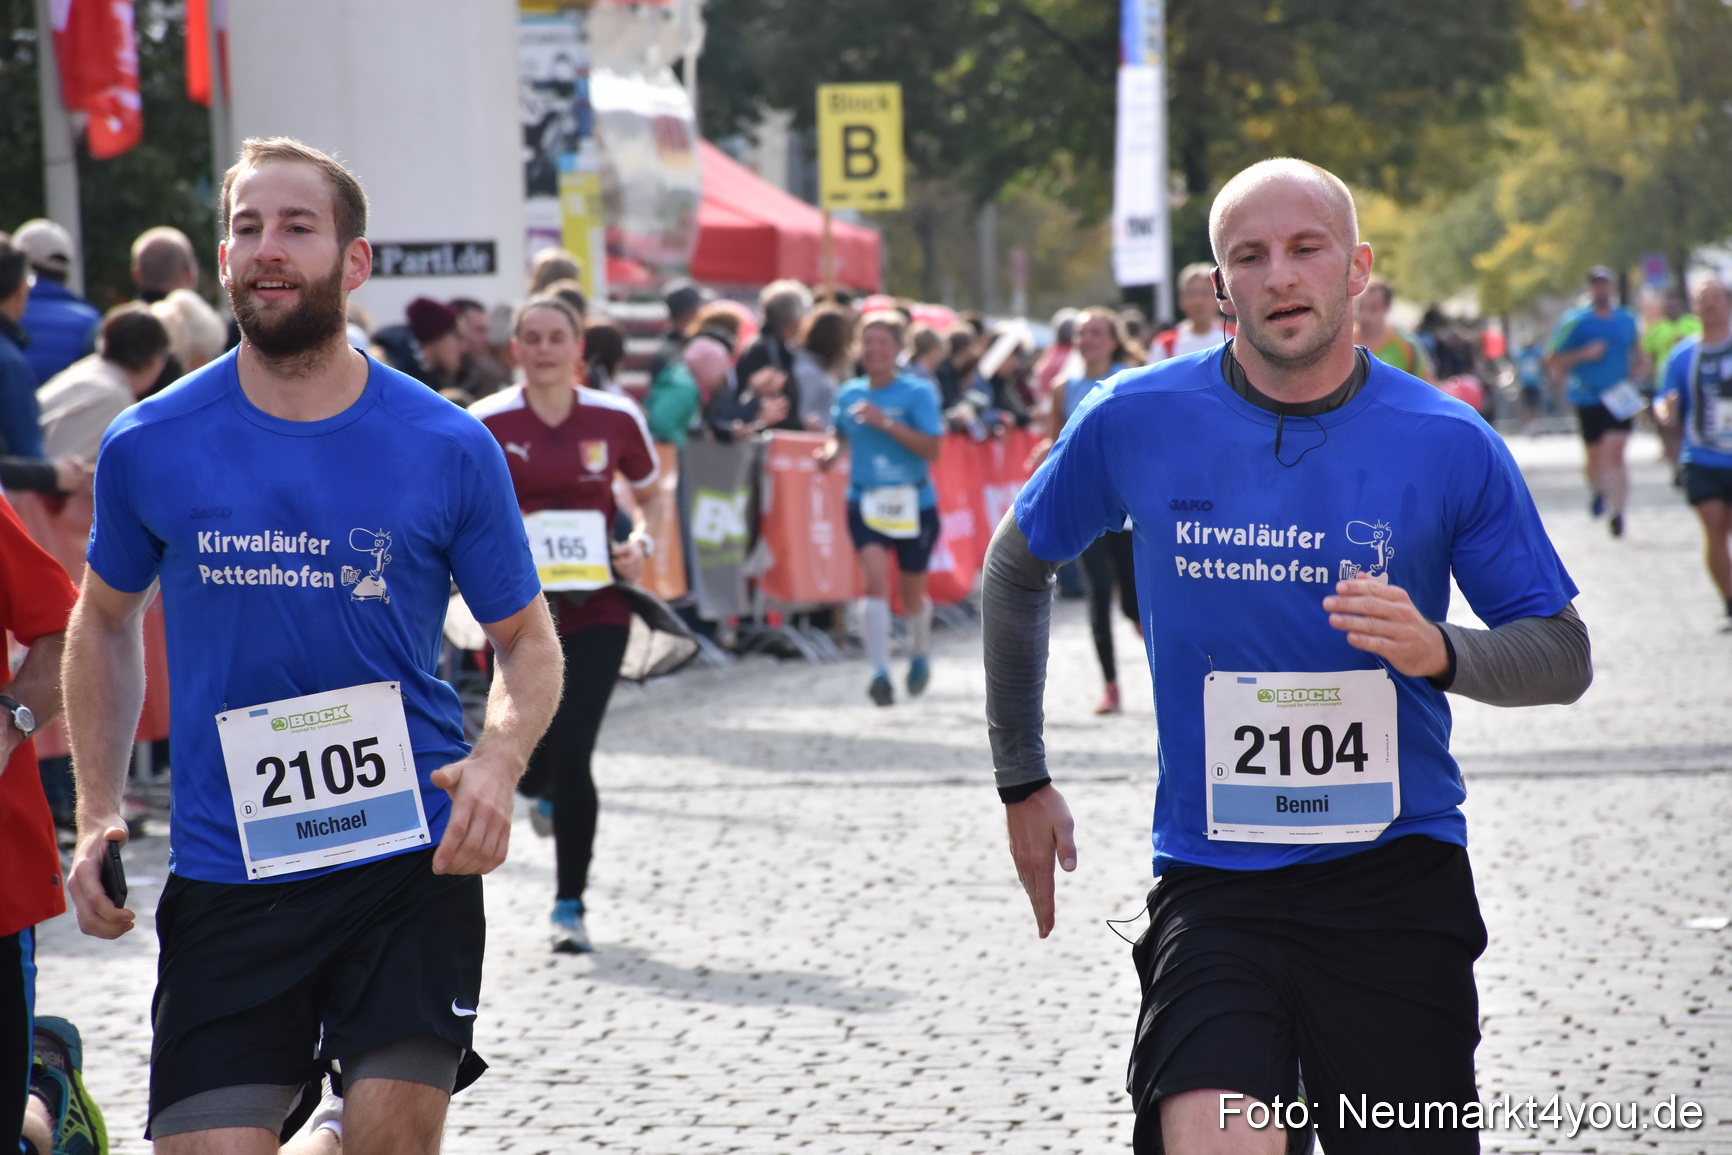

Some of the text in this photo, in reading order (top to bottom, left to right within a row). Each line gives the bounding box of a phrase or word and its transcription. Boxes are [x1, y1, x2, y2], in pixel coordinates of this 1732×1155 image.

[842, 124, 881, 181] B
[1169, 499, 1214, 512] JAKO
[197, 529, 331, 556] Kirwaläufer
[1175, 519, 1326, 550] Kirwaläufer
[543, 536, 588, 561] 165
[198, 563, 335, 589] Pettenhofen
[1174, 555, 1329, 584] Pettenhofen
[1276, 688, 1341, 702] BOCK
[289, 704, 351, 728] BOCK
[1234, 721, 1369, 776] 2104
[256, 736, 386, 808] 2105
[1216, 766, 1224, 777] D
[244, 805, 252, 815] D
[1275, 794, 1330, 814] Benni
[295, 809, 368, 840] Michael
